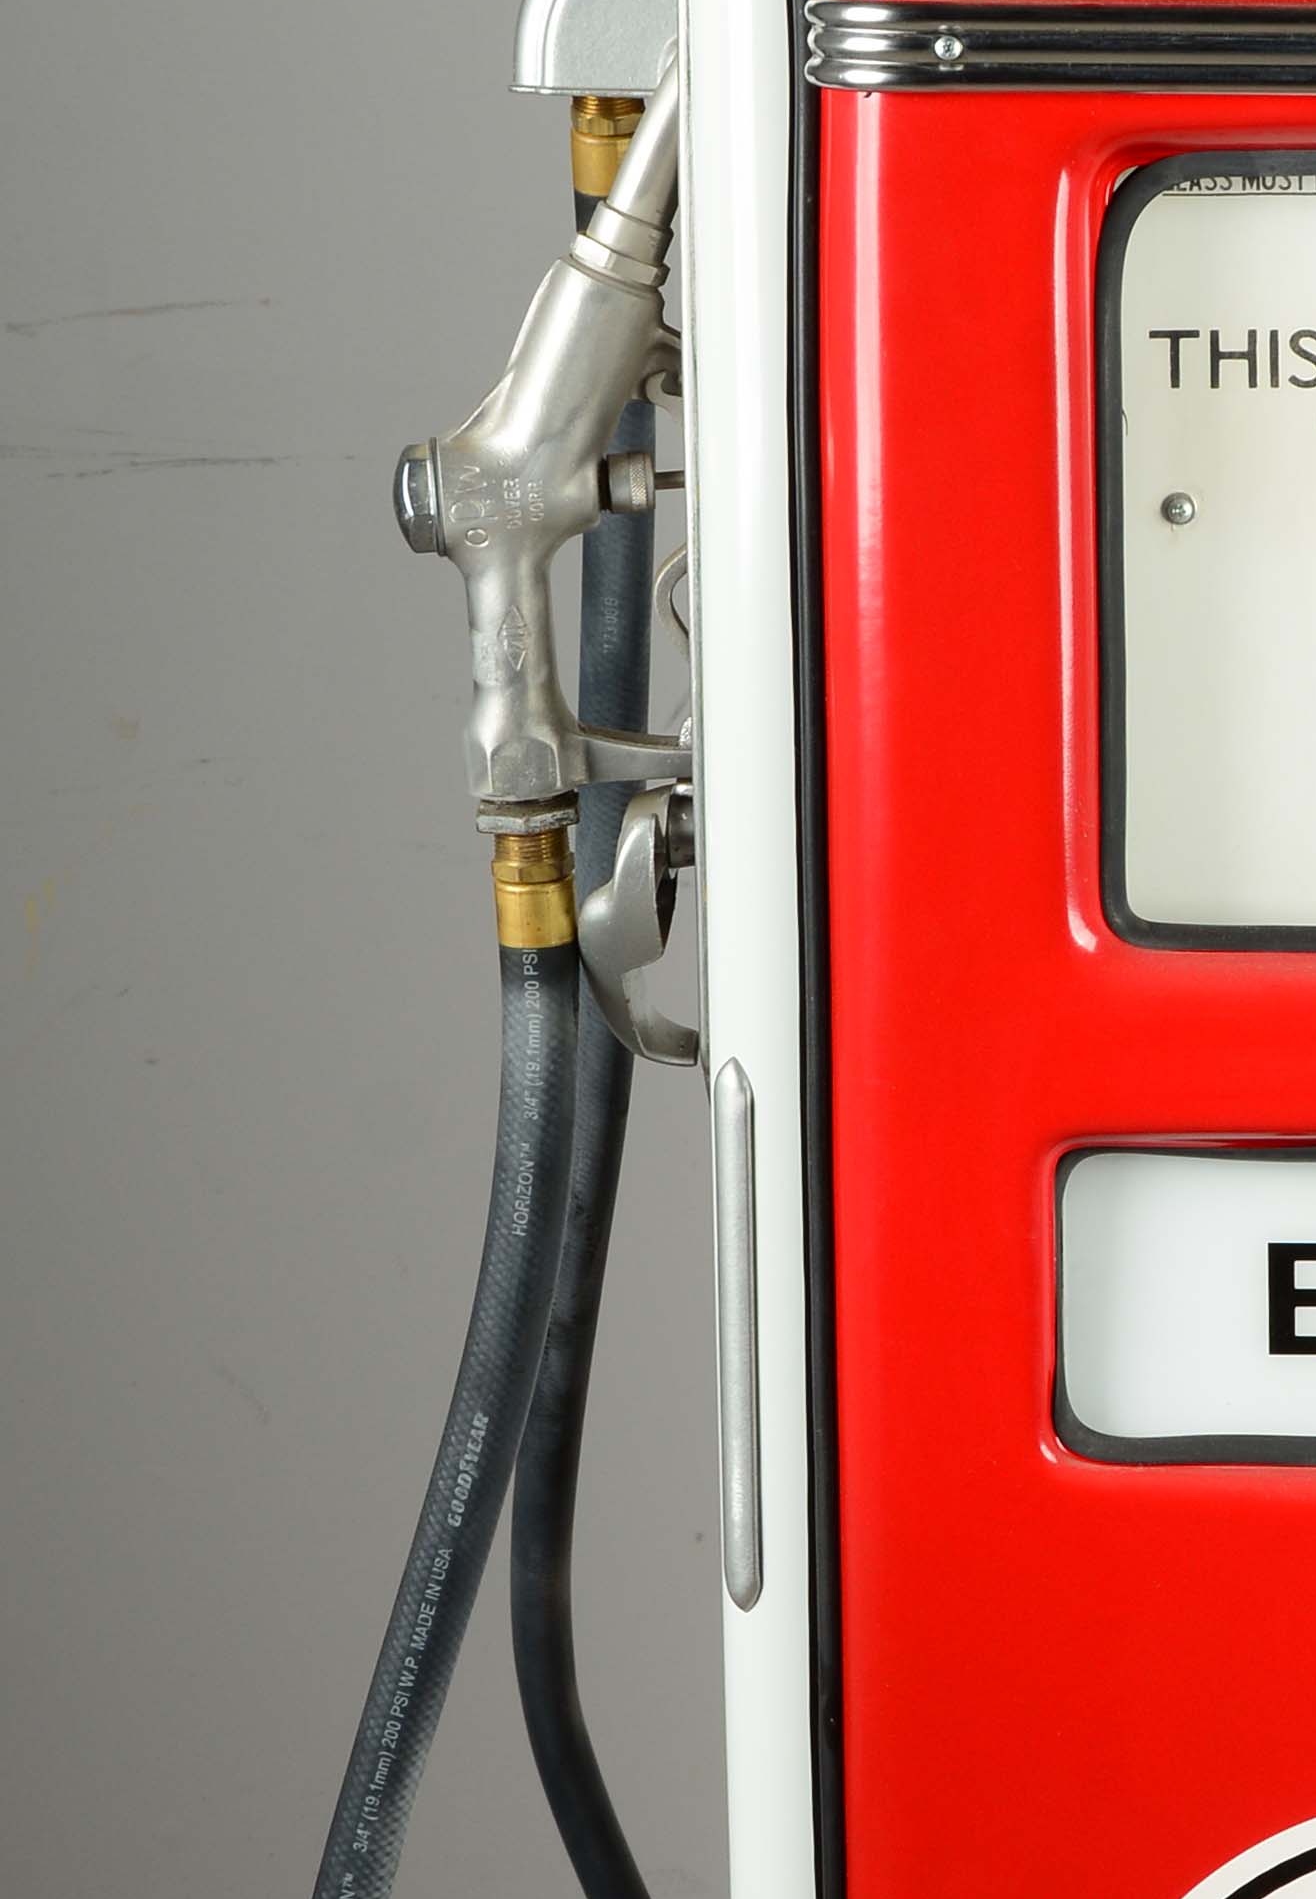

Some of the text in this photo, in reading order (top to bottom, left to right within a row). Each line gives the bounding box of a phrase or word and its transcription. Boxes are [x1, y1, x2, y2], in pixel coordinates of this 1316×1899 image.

[1171, 177, 1233, 191] LASS
[523, 948, 539, 976] PSI
[524, 980, 540, 1009] 200
[448, 1412, 489, 1528] GOODYEAR
[432, 1548, 454, 1578] USA
[425, 1583, 442, 1601] IN
[411, 1602, 437, 1651] MADE
[399, 1654, 422, 1689] W.P.
[390, 1686, 411, 1718] PSI
[381, 1719, 401, 1749] 200
